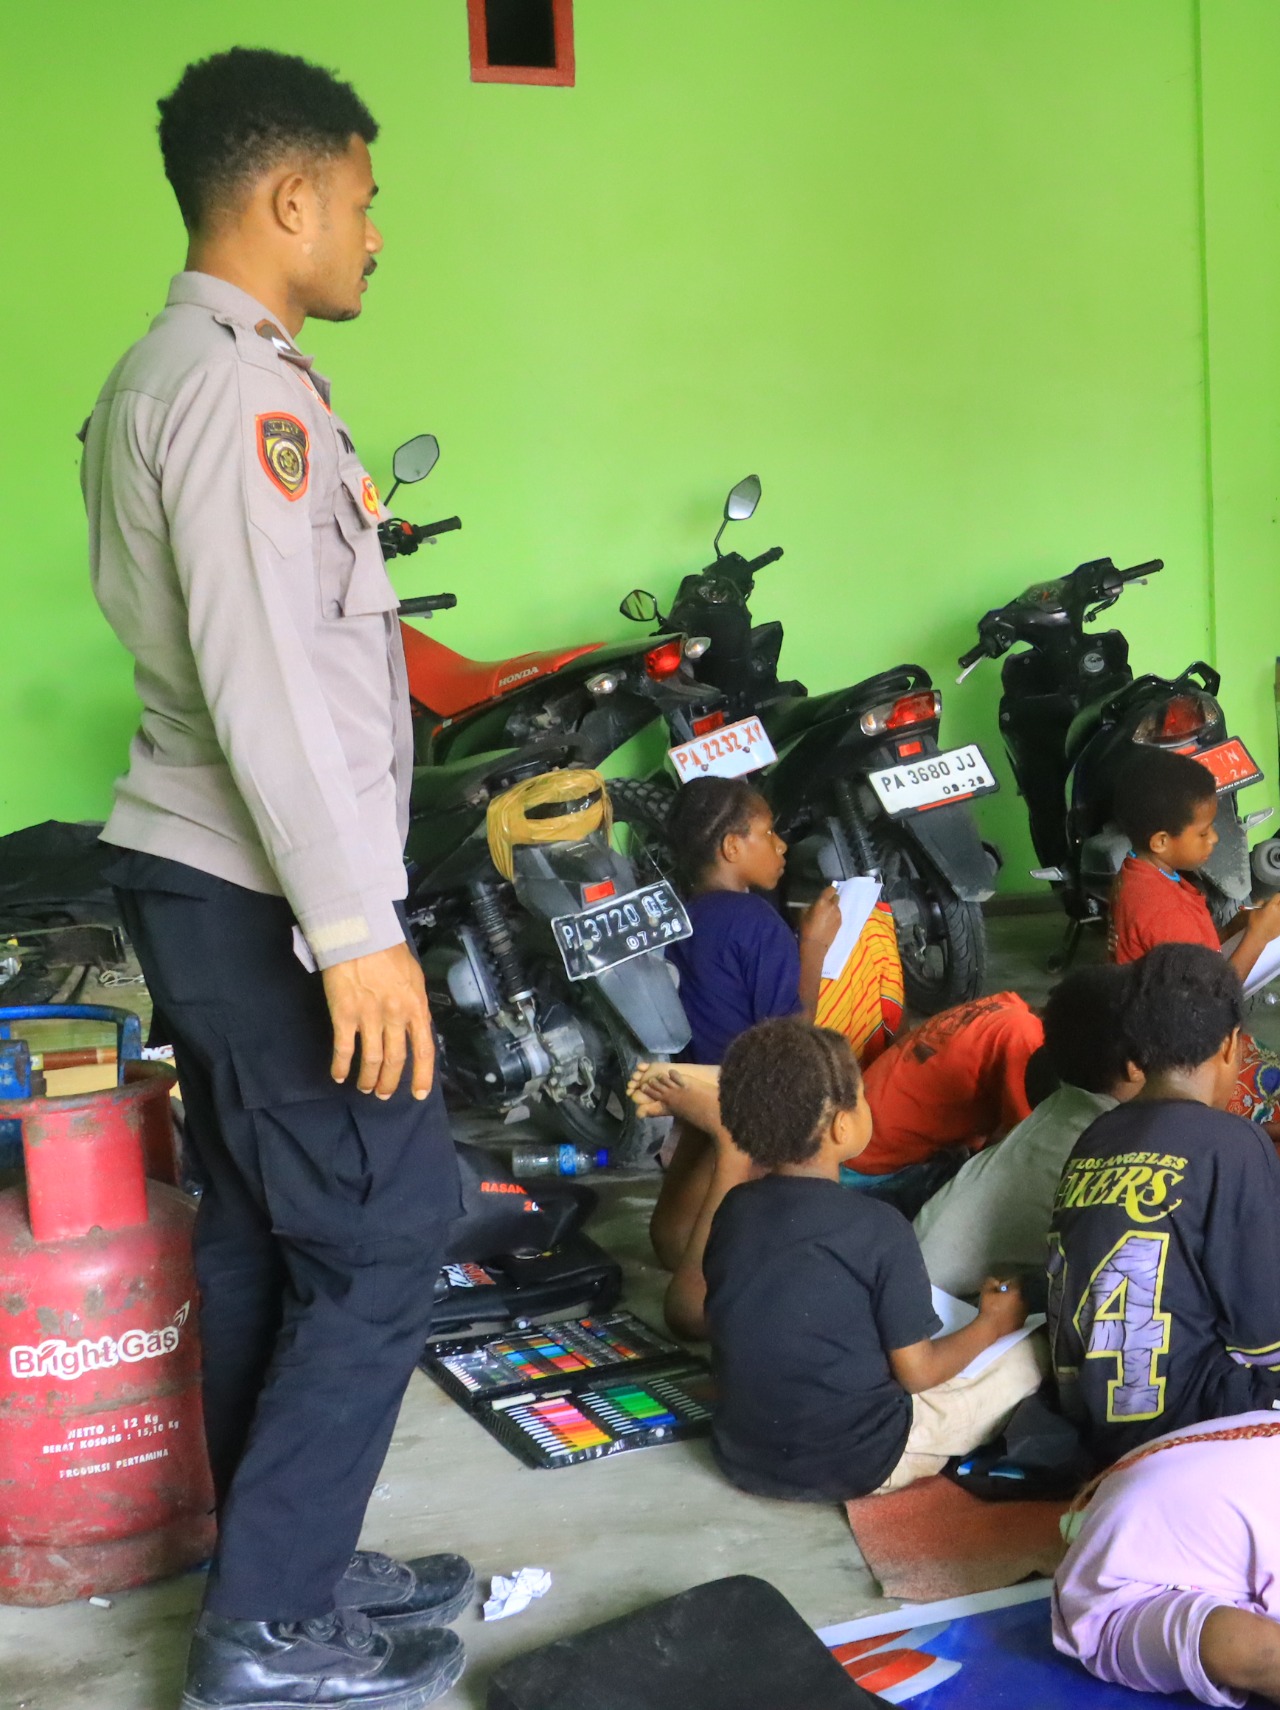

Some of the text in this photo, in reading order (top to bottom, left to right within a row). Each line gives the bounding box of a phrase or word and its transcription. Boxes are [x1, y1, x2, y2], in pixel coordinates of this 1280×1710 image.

[498, 666, 539, 687] HONDA
[881, 753, 976, 793] PA 3680 JJ
[583, 903, 641, 943] 3720
[1076, 1152, 1188, 1171] LOS ANGELES
[480, 1181, 529, 1195] RASAK
[11, 1325, 179, 1380] Bright Gas
[66, 1424, 105, 1440] NETTO
[123, 1417, 139, 1430] 12
[144, 1414, 159, 1425] Kg
[42, 1442, 75, 1455] BERAT
[80, 1433, 122, 1449] KOSONG
[59, 1449, 169, 1479] PRODUKSI PERTAMINA
